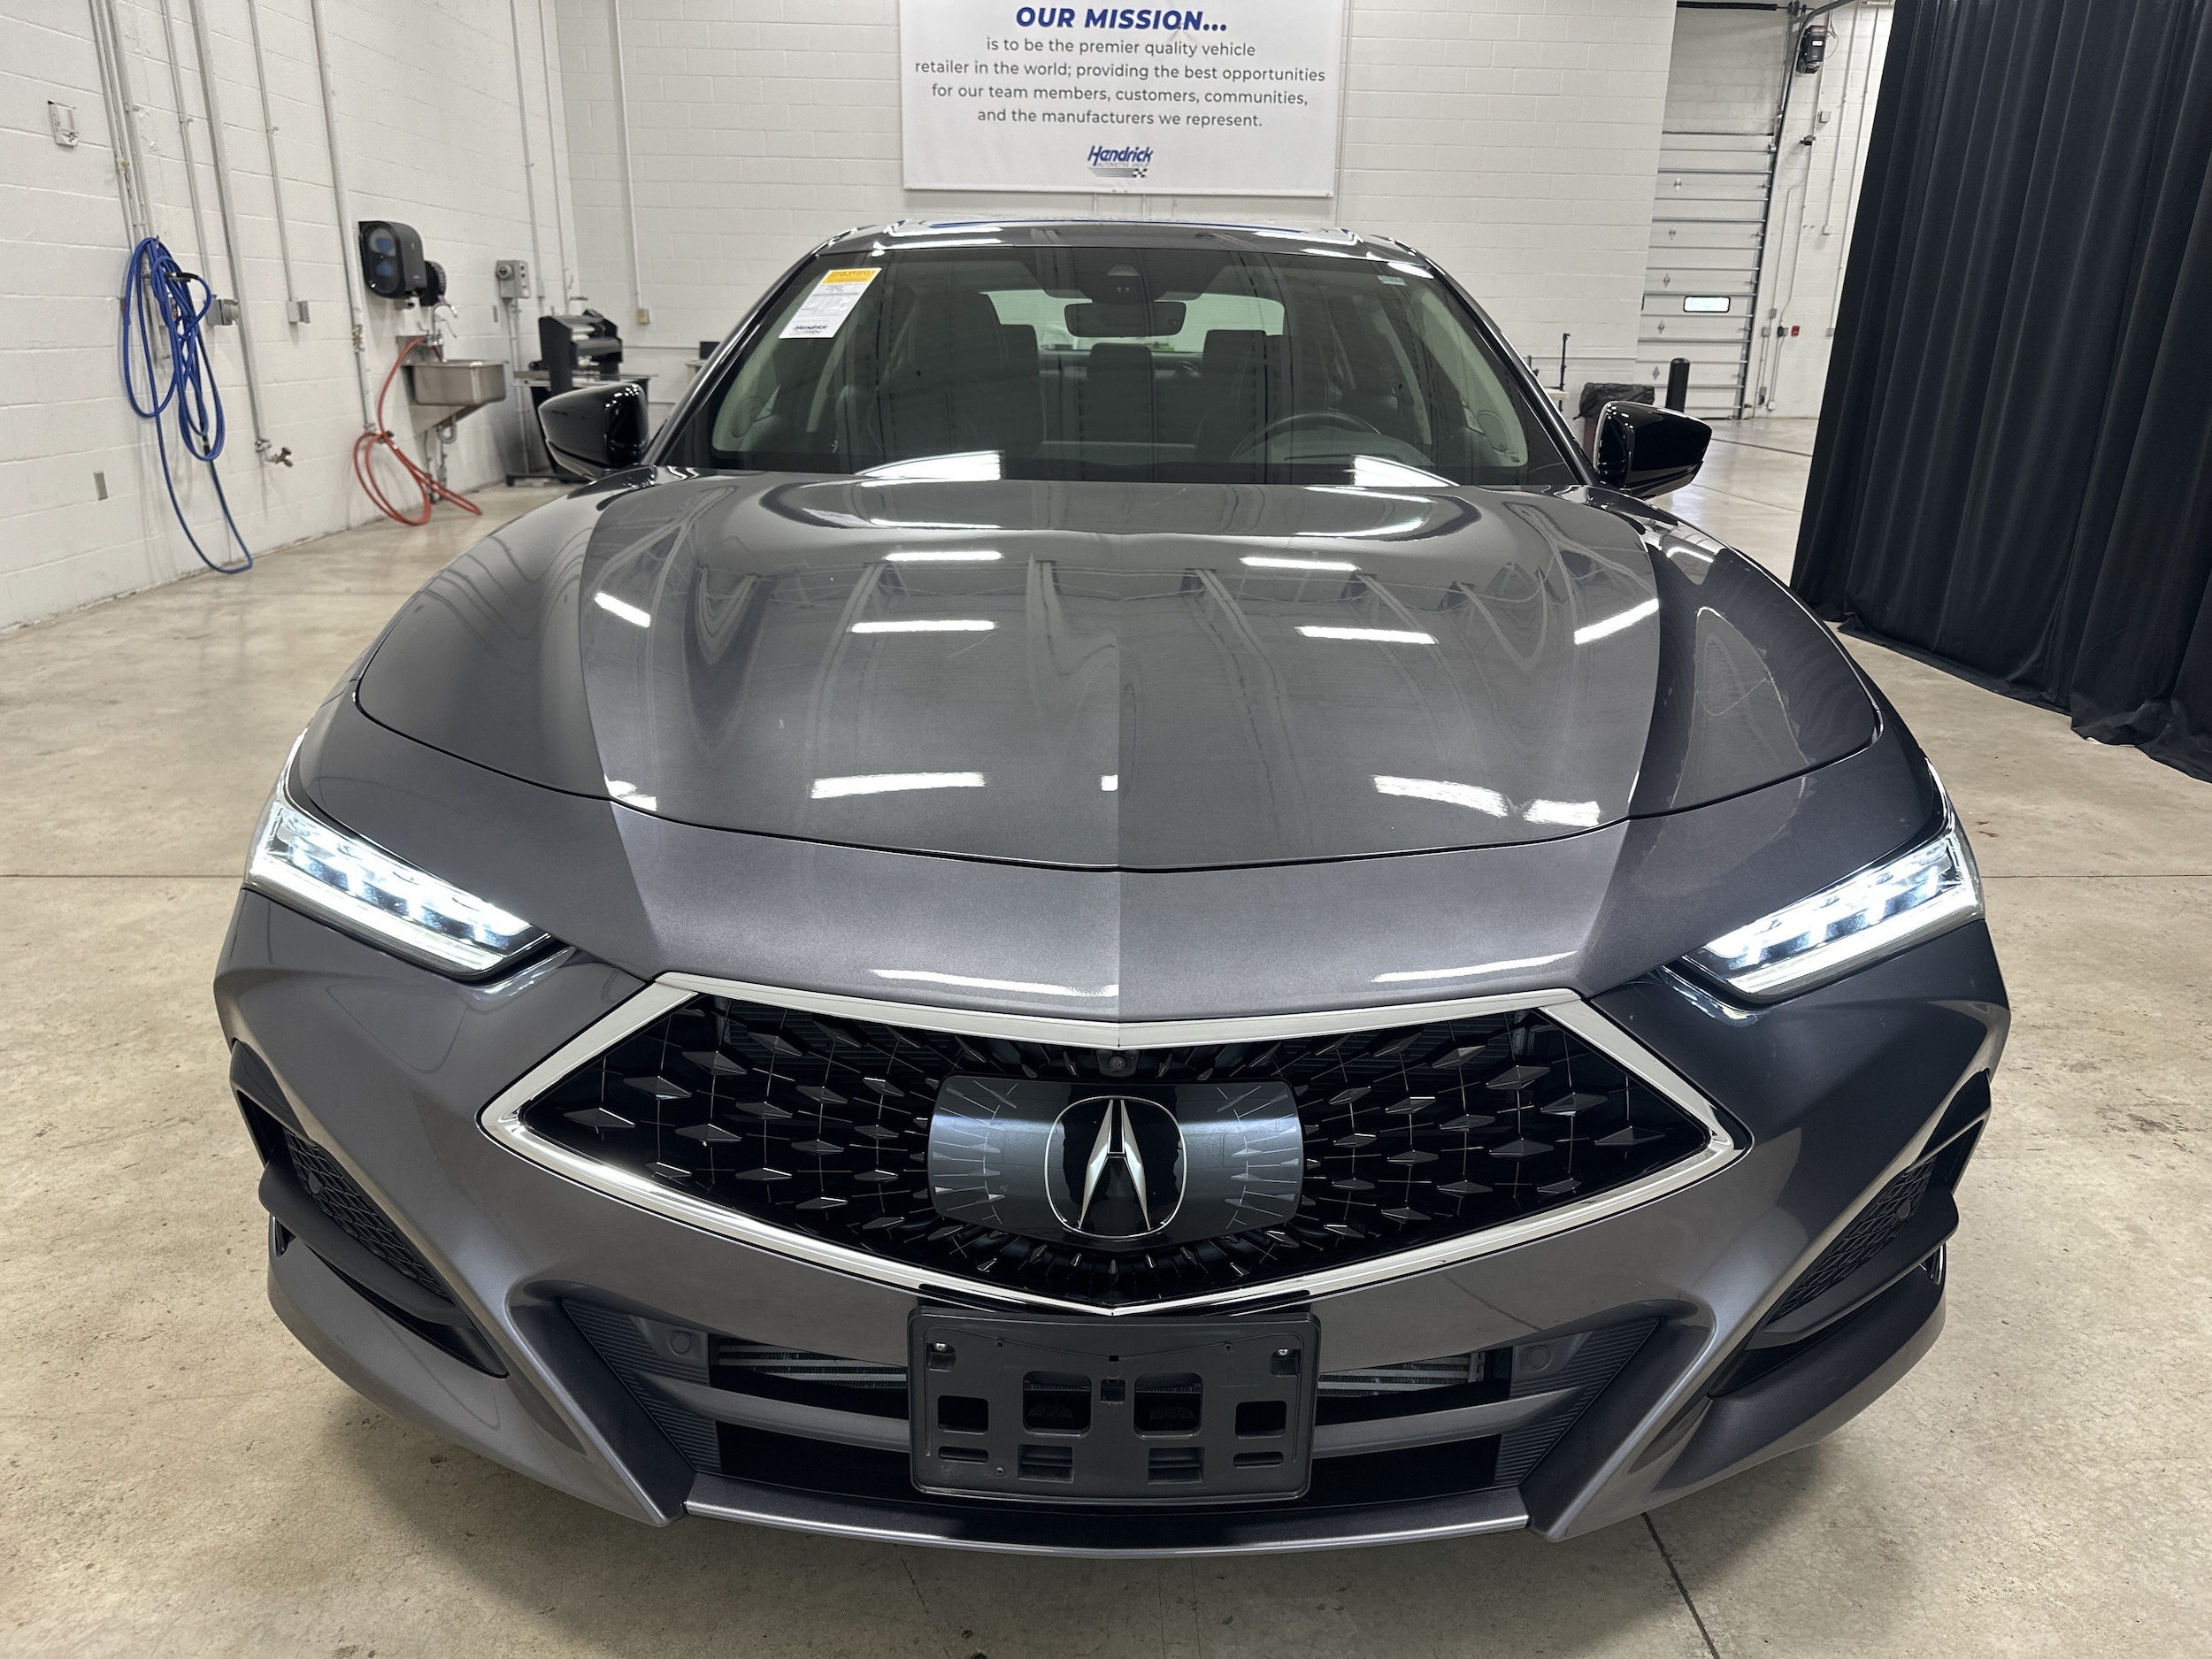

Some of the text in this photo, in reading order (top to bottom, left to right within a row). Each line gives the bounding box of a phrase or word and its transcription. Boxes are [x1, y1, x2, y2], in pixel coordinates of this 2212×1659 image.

[1016, 7, 1227, 32] OUR MISSION...
[987, 37, 1256, 58] is to be the premier quality vehicle
[916, 59, 1326, 82] retailer in the world; providing the best opportunities
[932, 83, 1308, 106] for our team members, customers, communities,
[978, 108, 1263, 128] and the manufacturers we represent.
[1087, 145, 1154, 166] Hendrick
